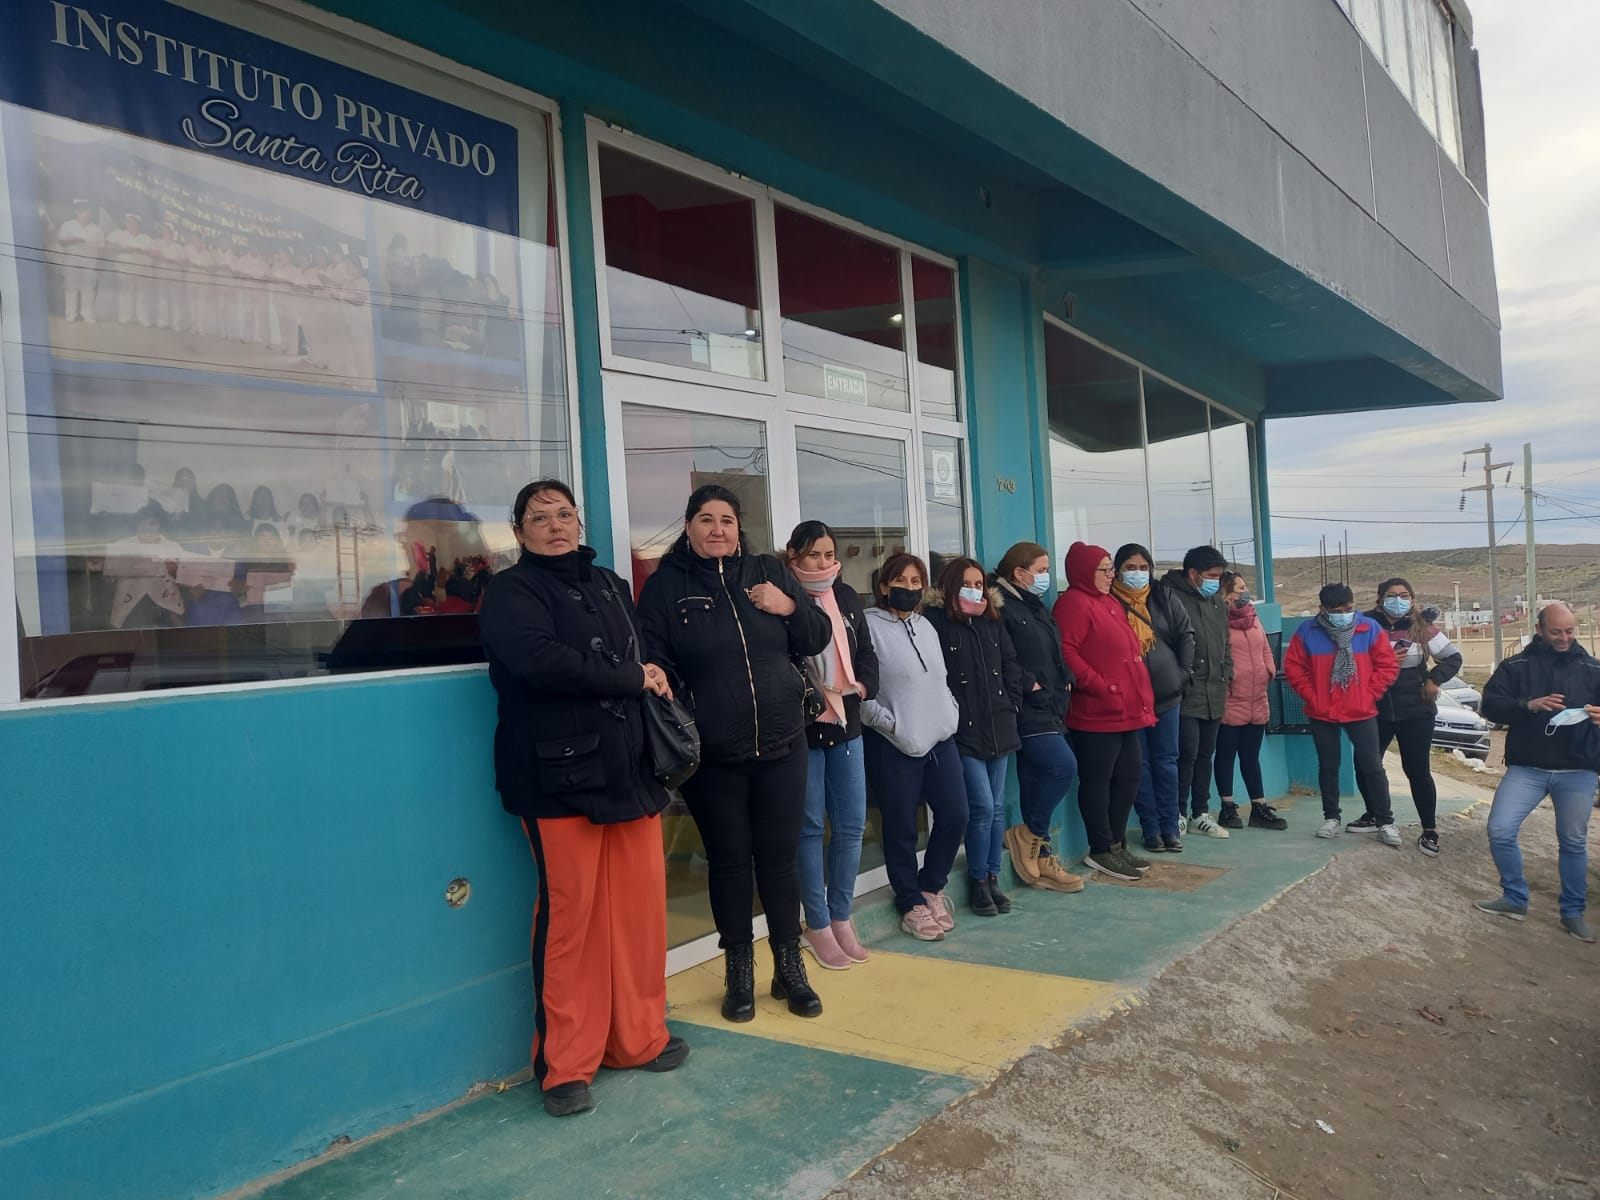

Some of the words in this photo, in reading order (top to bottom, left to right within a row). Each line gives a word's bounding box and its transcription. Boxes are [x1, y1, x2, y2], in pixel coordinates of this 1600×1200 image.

[51, 2, 323, 121] INSTITUTO
[334, 94, 496, 176] PRIVADO
[182, 99, 327, 173] Santa
[331, 142, 424, 200] Rita
[827, 375, 864, 396] ENTRADA
